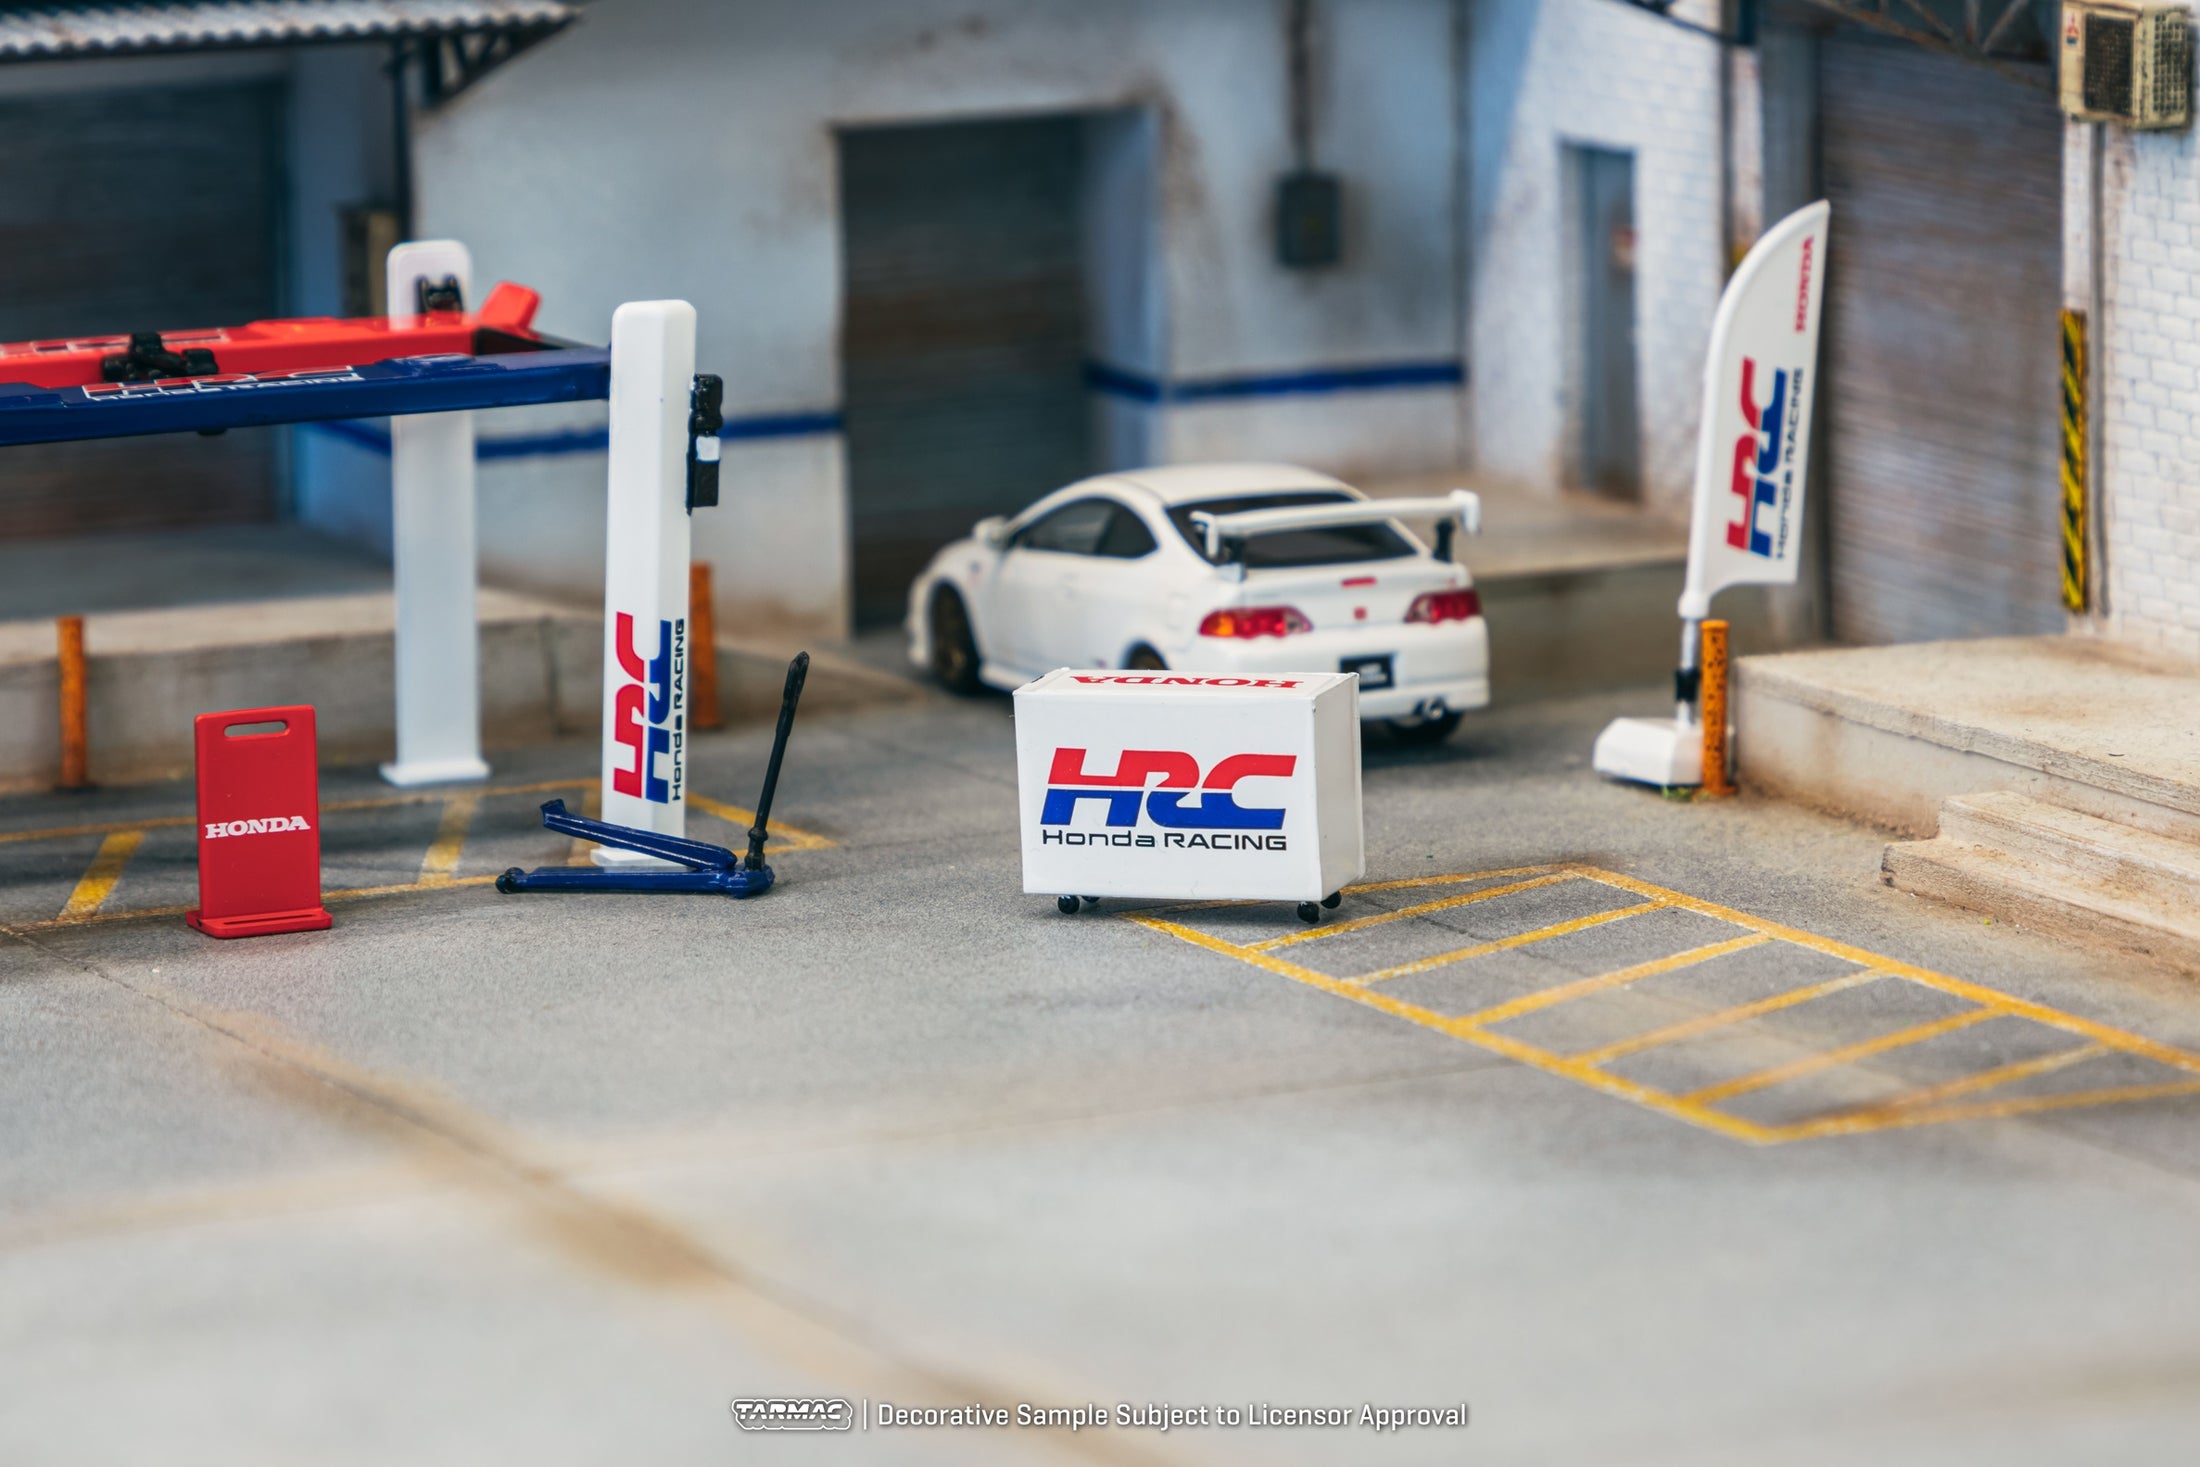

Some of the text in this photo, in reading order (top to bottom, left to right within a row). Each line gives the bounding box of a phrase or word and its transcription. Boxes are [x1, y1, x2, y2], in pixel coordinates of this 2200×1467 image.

[1795, 236, 1814, 331] HONDA
[1726, 356, 1787, 558] HRC
[1784, 368, 1803, 463] RACING
[613, 611, 672, 804] HRC
[672, 618, 685, 801] Honda RACING
[1070, 676, 1304, 689] HONDA
[205, 815, 311, 839] HONDA
[1040, 747, 1297, 830] HRC
[1042, 829, 1287, 851] Honda RACING
